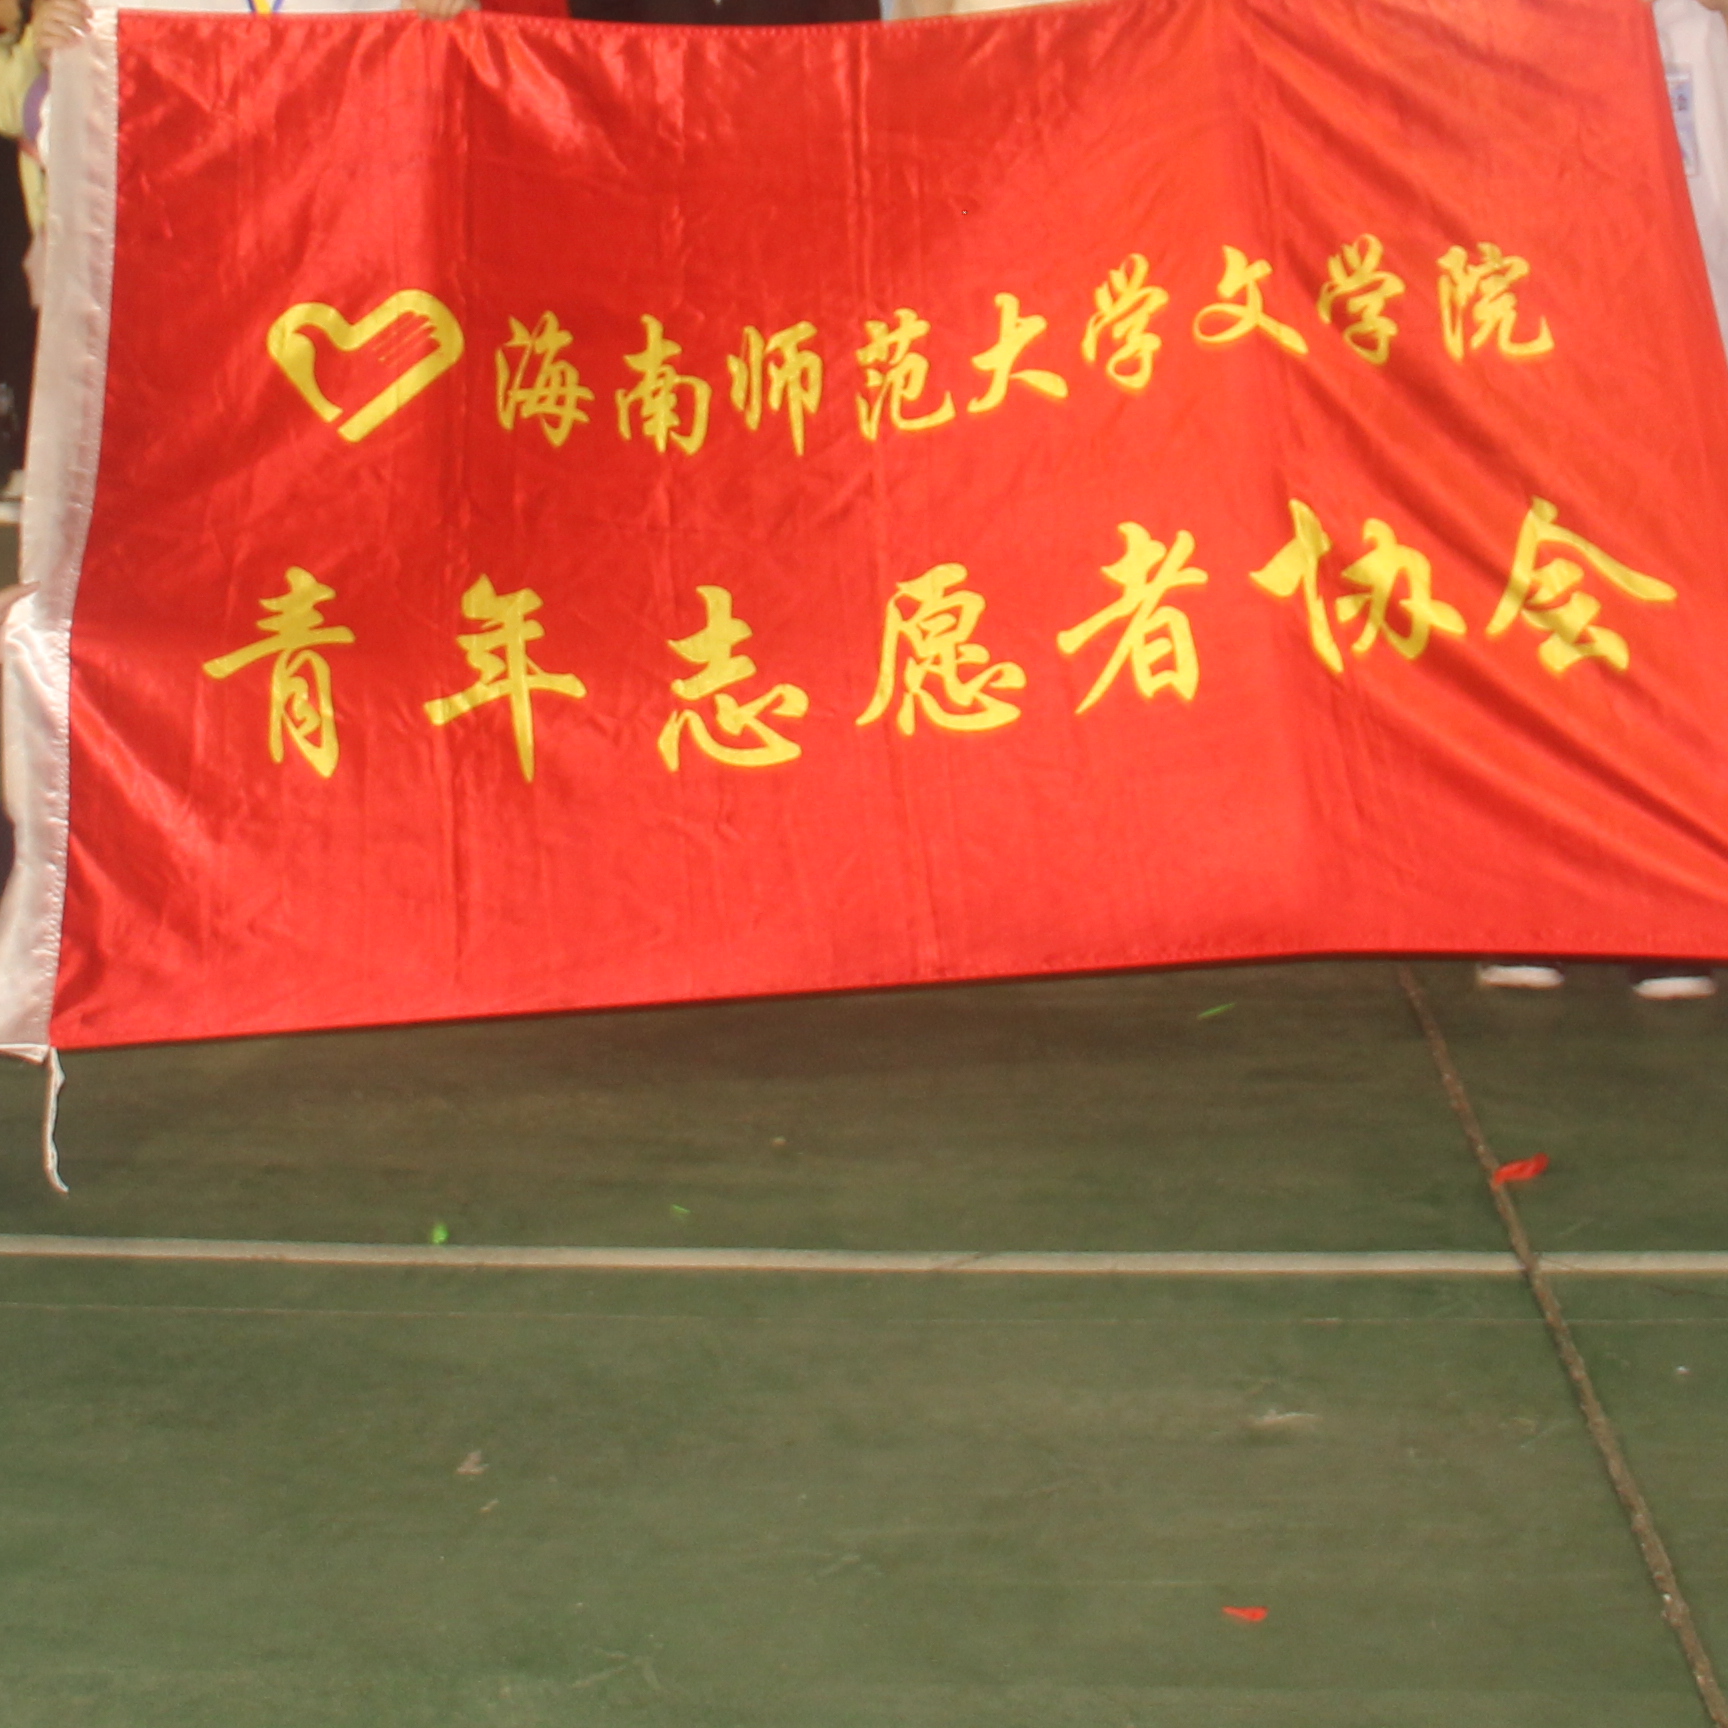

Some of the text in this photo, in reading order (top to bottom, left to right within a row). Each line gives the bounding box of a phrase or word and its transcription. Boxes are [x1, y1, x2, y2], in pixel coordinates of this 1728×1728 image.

[497, 232, 1557, 458] 海南师范大学文学院
[202, 497, 1678, 782] 青年志愿者协会
